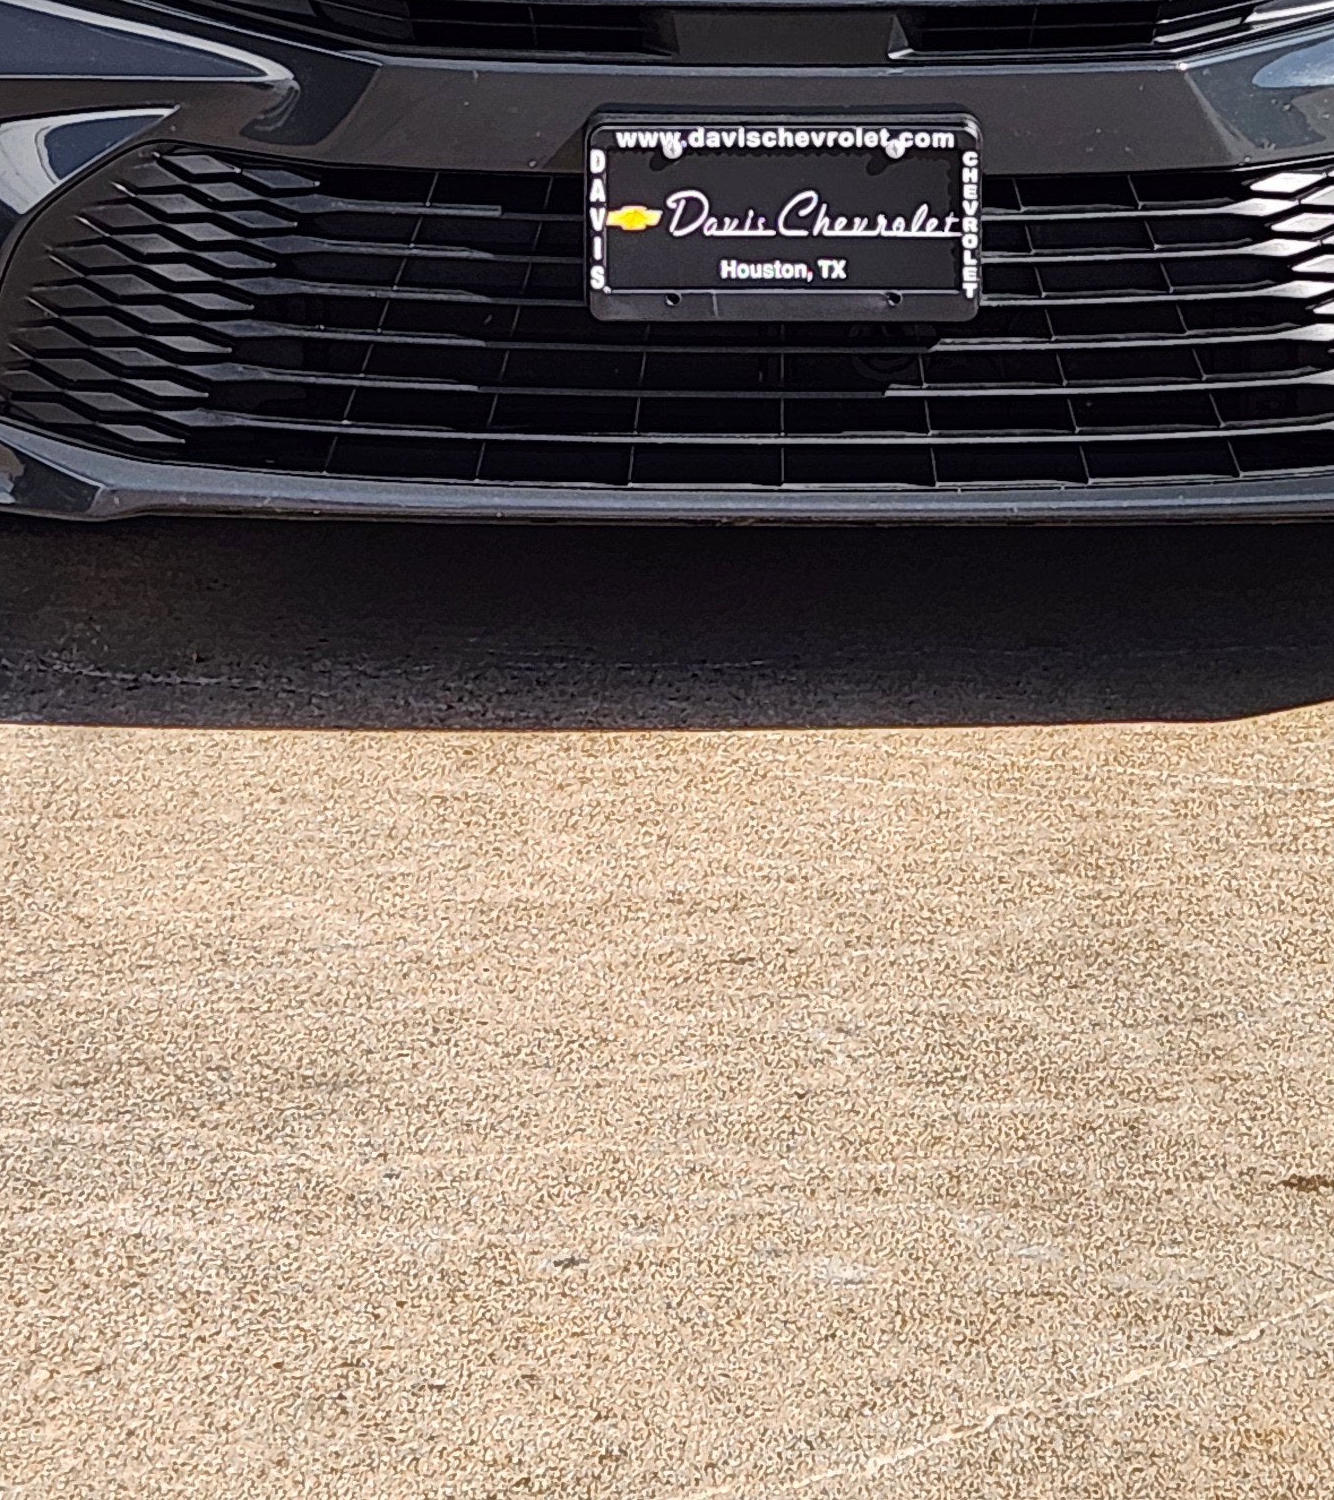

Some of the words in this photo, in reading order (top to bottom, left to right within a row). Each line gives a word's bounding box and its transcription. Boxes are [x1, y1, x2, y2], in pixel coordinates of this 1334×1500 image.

[615, 127, 955, 150] www.davischevroletcom
[589, 149, 607, 290] DAVIS
[666, 190, 777, 236] Davis
[778, 190, 962, 237] Chevrolet
[962, 151, 979, 298] CHEVROLET
[720, 259, 814, 282] Houston,
[818, 259, 847, 279] TX
